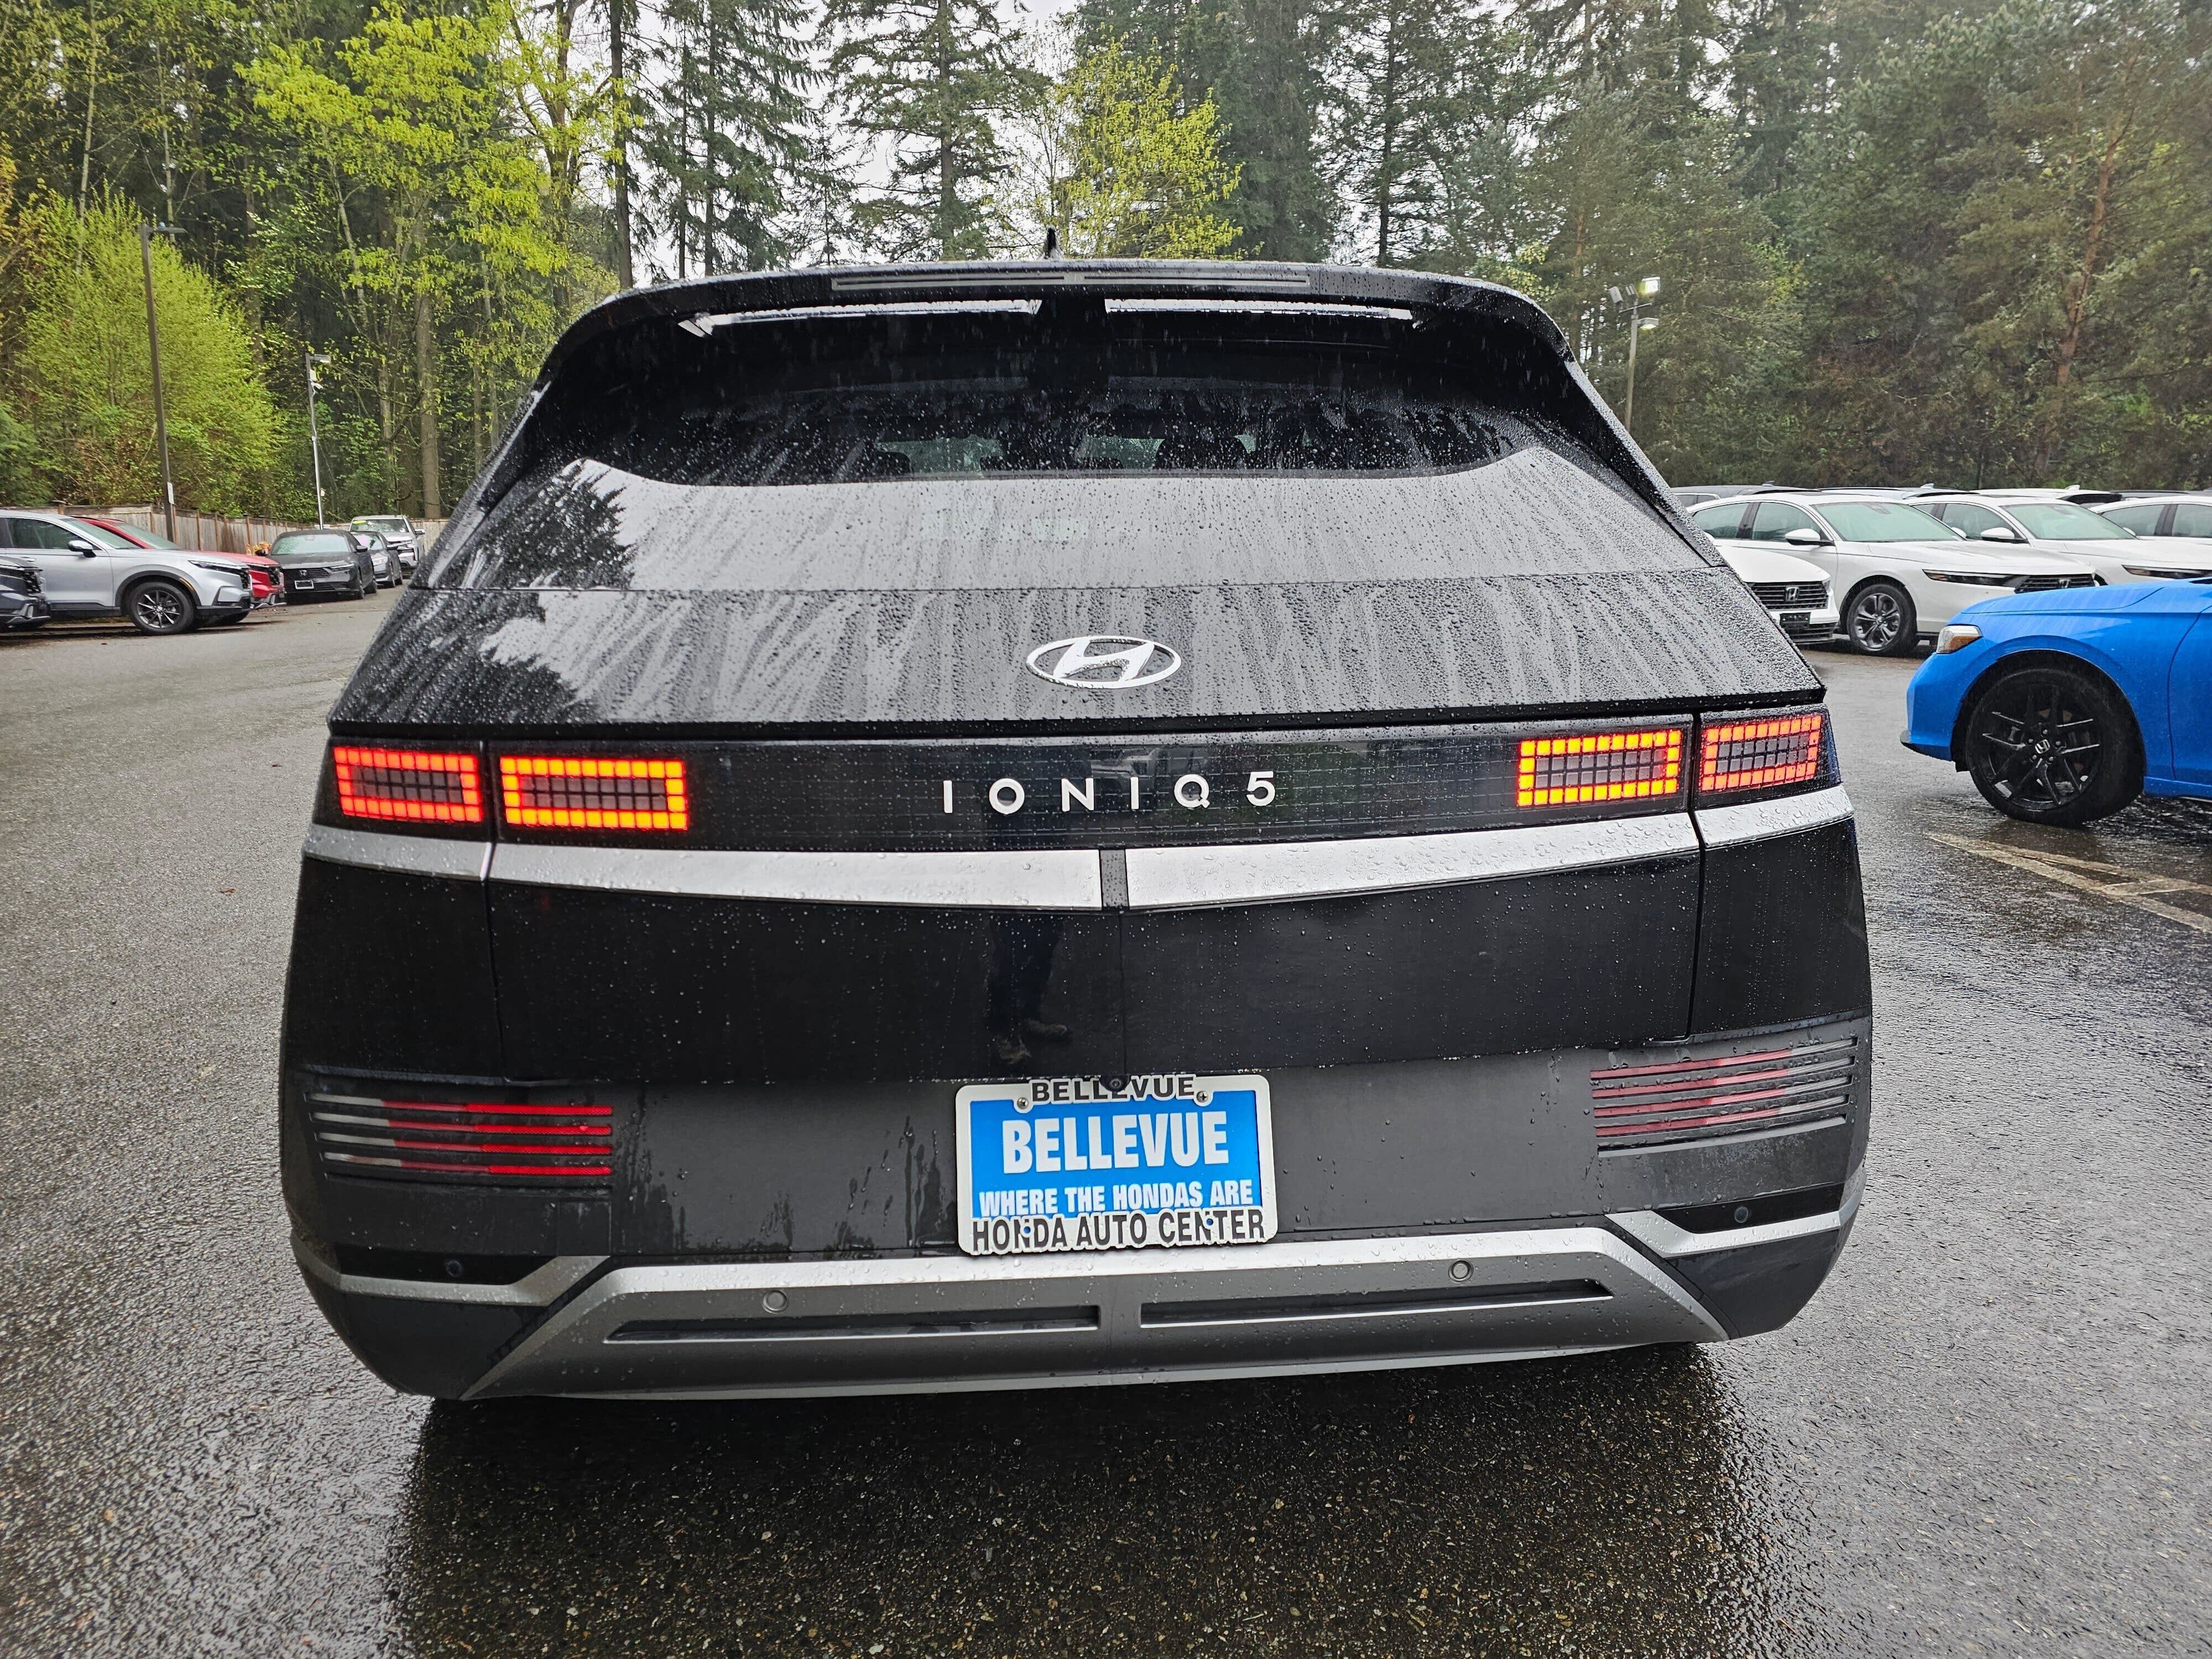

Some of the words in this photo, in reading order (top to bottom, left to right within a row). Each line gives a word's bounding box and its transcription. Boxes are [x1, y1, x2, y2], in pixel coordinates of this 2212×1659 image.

[943, 774, 1211, 815] IONIQ
[1246, 771, 1275, 807] 5
[1031, 1076, 1194, 1102] BELLVUE
[1002, 1110, 1229, 1174] BELLEVUE
[979, 1188, 1058, 1217] WHERE
[1064, 1186, 1105, 1213] THE
[1113, 1182, 1203, 1211] HONDAS
[1209, 1179, 1254, 1206] ARE
[973, 1217, 1068, 1252] HONDA
[1076, 1213, 1147, 1246] AUTO
[1159, 1209, 1265, 1244] CENTER
